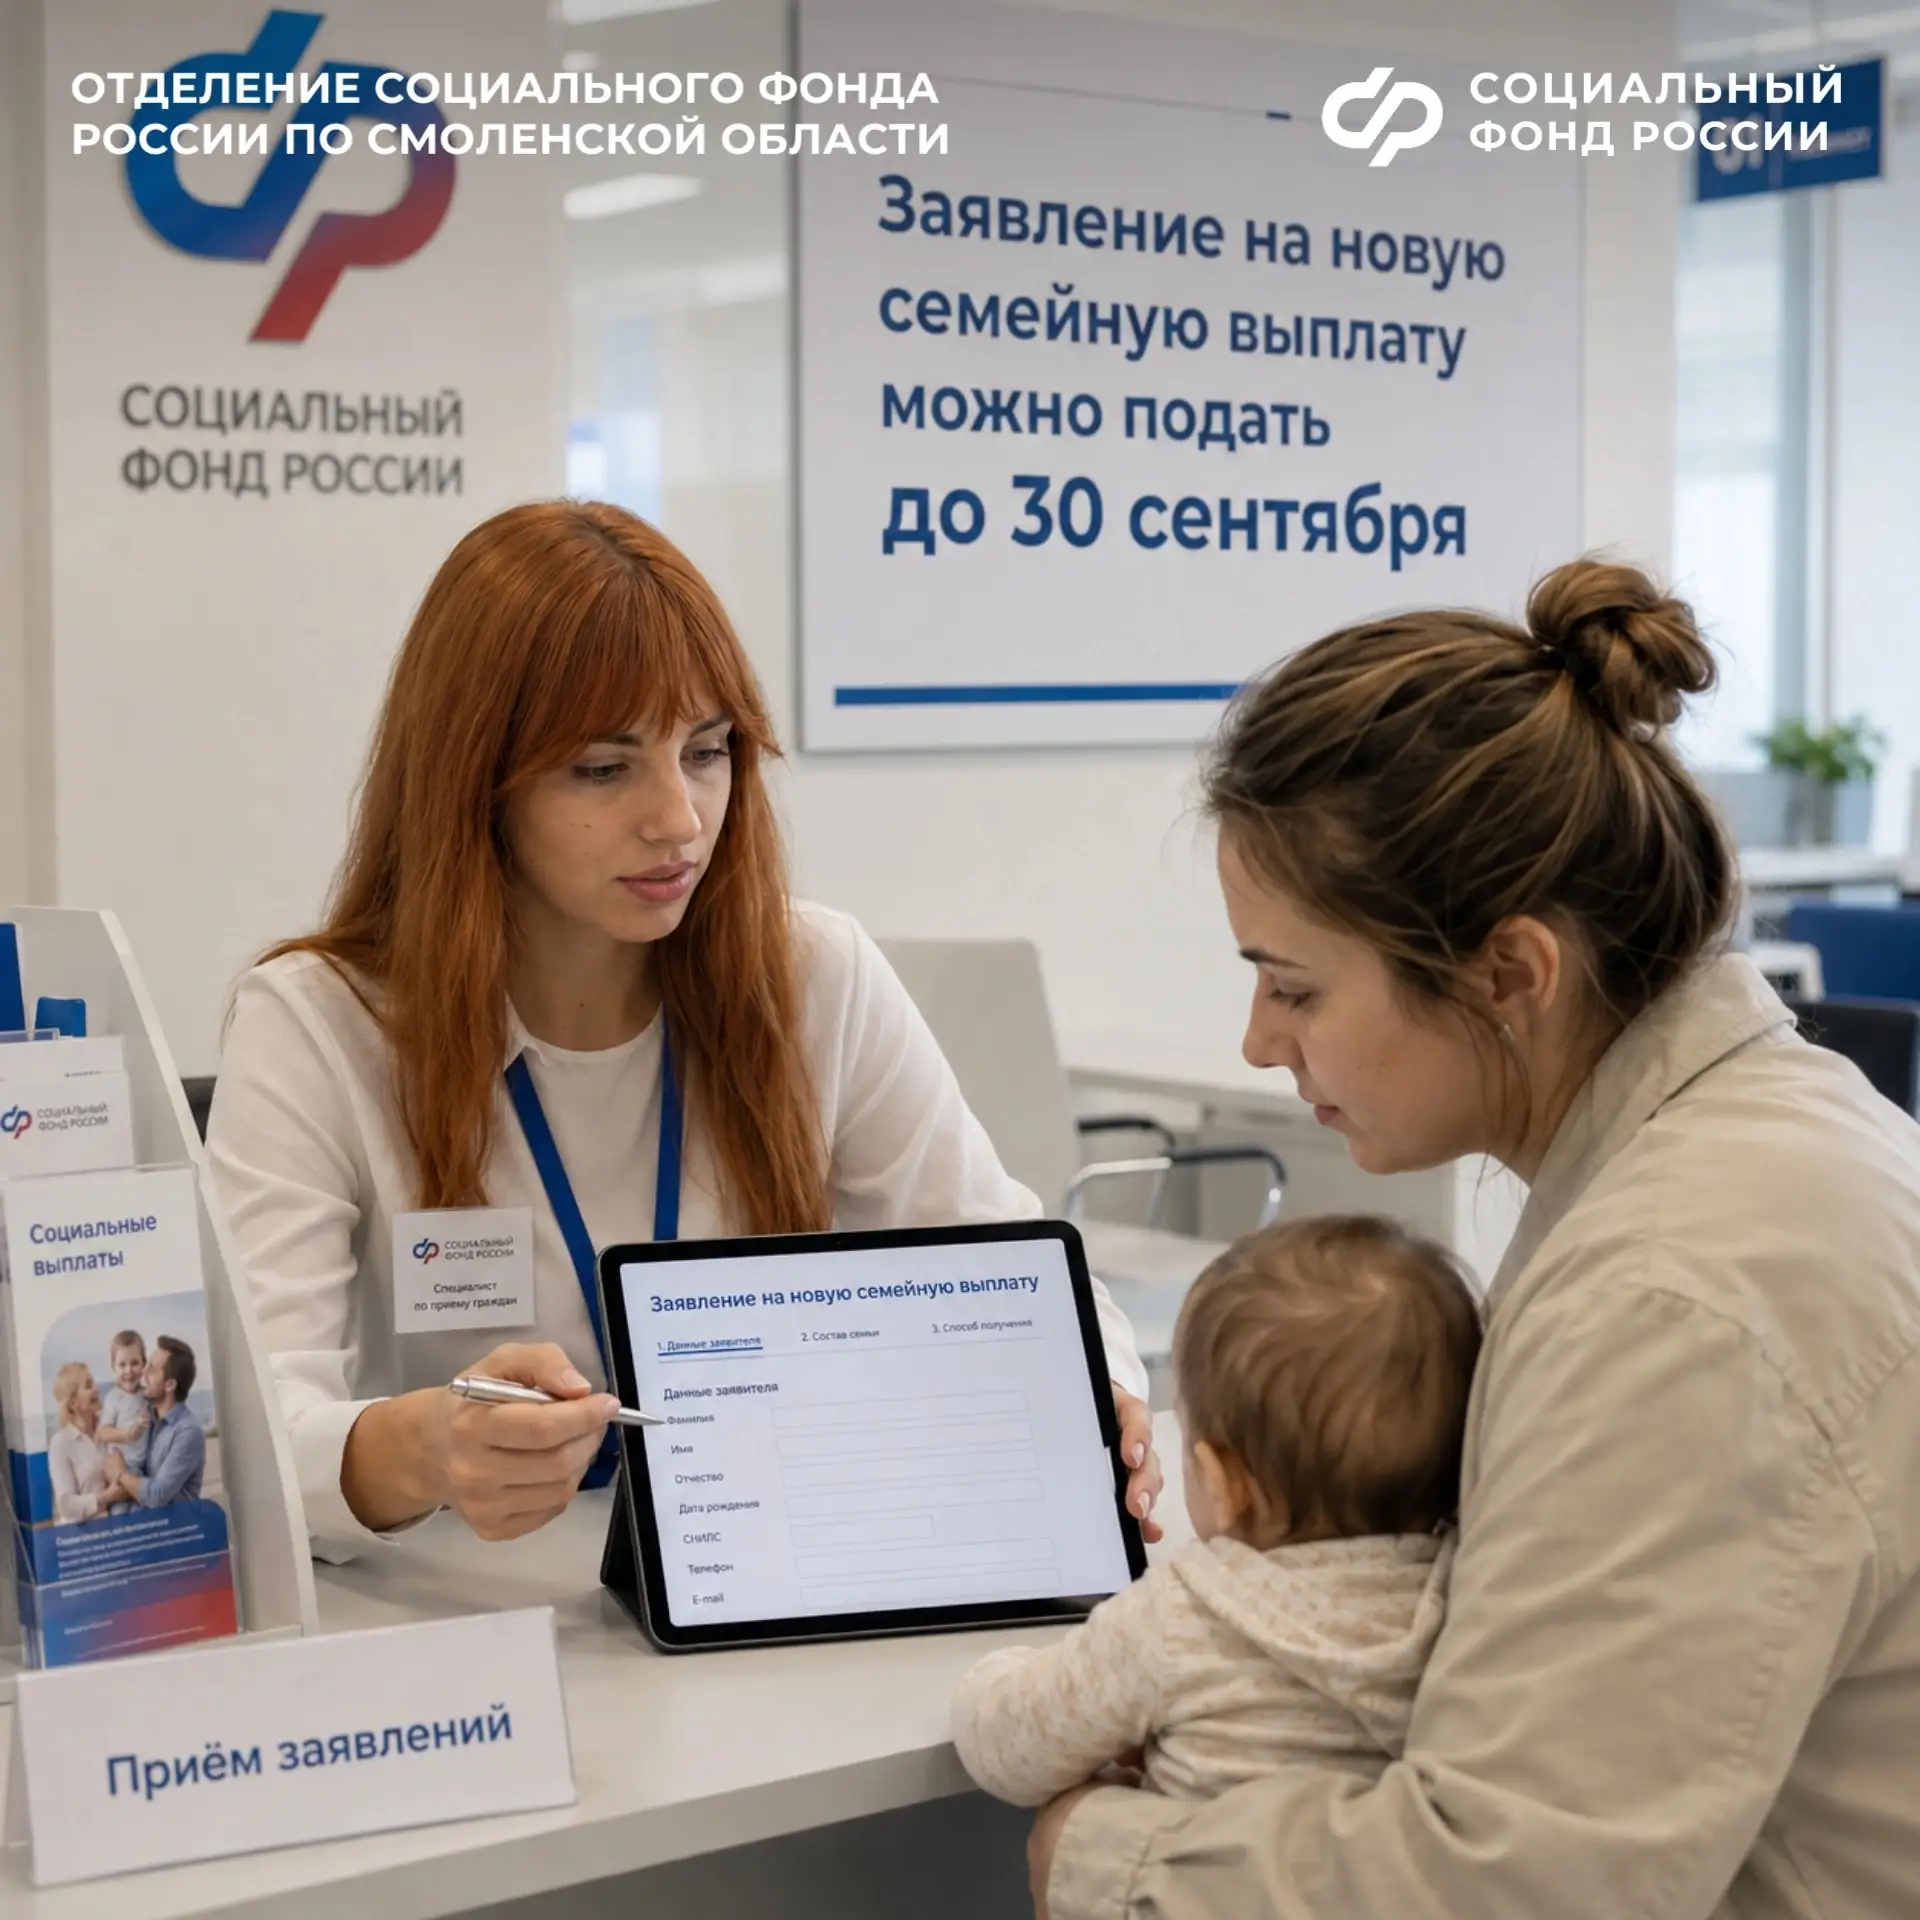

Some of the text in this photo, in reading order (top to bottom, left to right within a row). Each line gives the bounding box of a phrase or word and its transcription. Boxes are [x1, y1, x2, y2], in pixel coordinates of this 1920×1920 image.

[878, 174, 1506, 291] Заявление на новую
[879, 283, 1467, 379] семейную выплату
[121, 384, 463, 437] СОЦИАЛЬНЫЙ
[882, 383, 1331, 452] можно подать
[121, 448, 463, 499] ФОНД РОССИИ
[882, 474, 1467, 572] до 30 сентября
[30, 1215, 157, 1244] Социальные
[33, 1250, 124, 1276] выплаты
[433, 1282, 498, 1294] Специалист
[651, 1273, 1039, 1312] Заявление на новую семейную выплату
[414, 1303, 429, 1311] по
[473, 1297, 518, 1310] граждан
[943, 1321, 979, 1333] Способ
[667, 1339, 707, 1351] Данные
[709, 1336, 762, 1348] заявителя
[801, 1332, 811, 1342] 2.
[812, 1330, 848, 1341] Состав
[663, 1382, 779, 1402] Данные заявителя
[666, 1414, 715, 1425] Фамилия
[670, 1444, 694, 1455] Имя
[674, 1472, 724, 1485] Отчество
[679, 1499, 760, 1515] Дата рождения
[682, 1532, 722, 1544] СНИЛС
[687, 1562, 734, 1576] Телефон
[692, 1592, 725, 1605] E-mail
[106, 1703, 512, 1800] Приём заявлений
